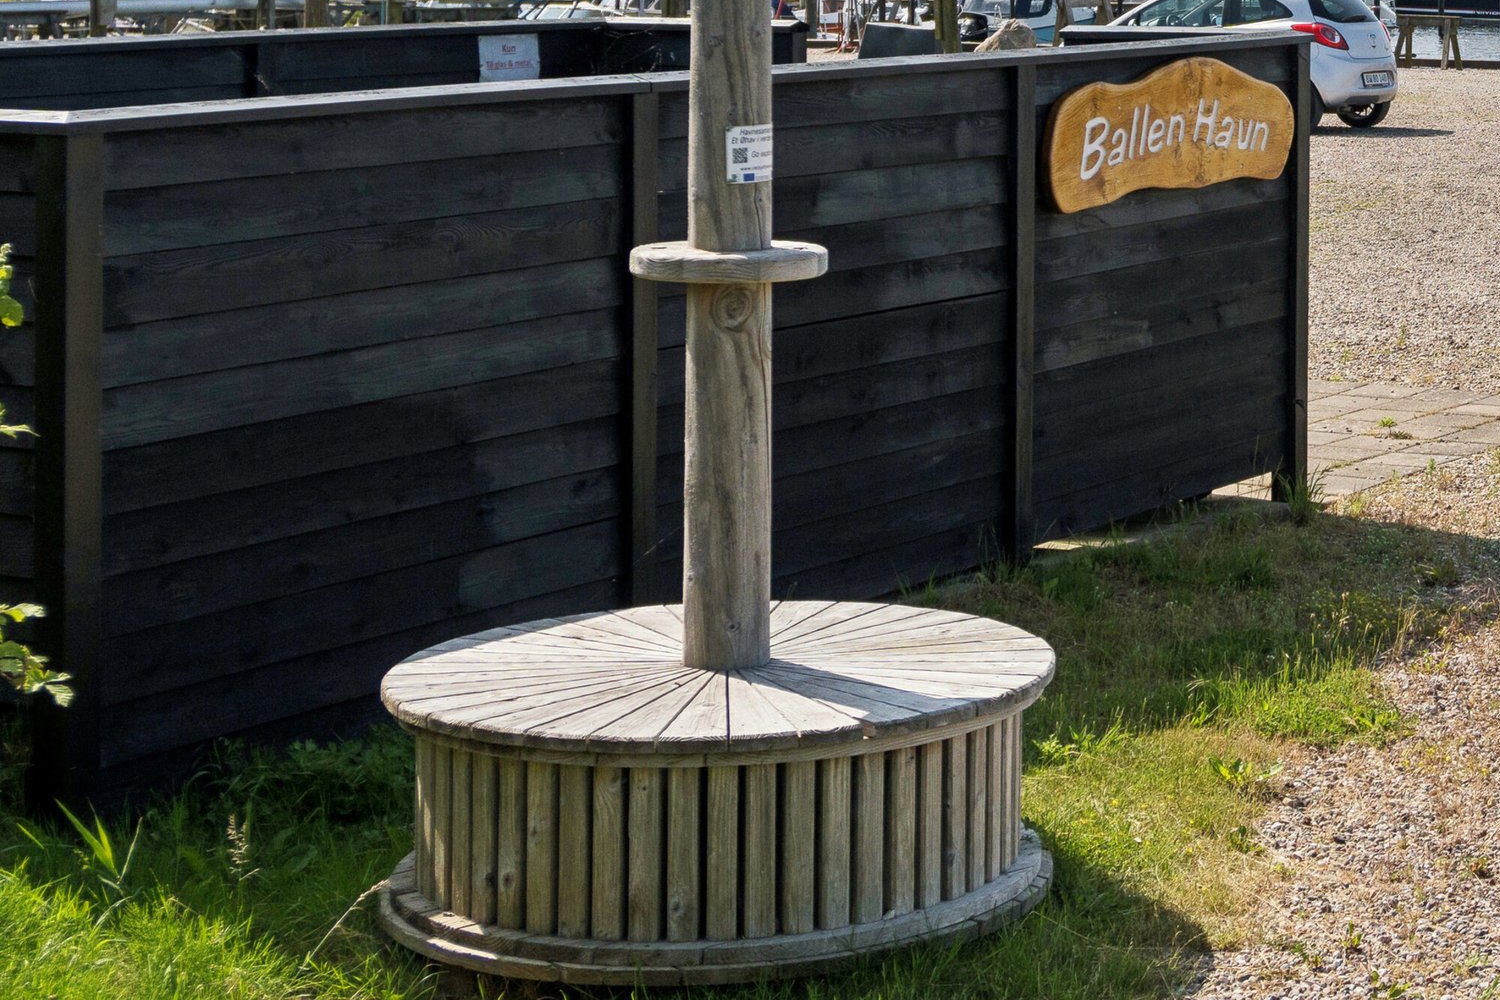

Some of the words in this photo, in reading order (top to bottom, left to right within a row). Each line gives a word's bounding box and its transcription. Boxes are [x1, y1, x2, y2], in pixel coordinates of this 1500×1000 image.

[501, 43, 516, 53] Kun
[1080, 103, 1185, 181] Ballen
[751, 150, 759, 158] Go
